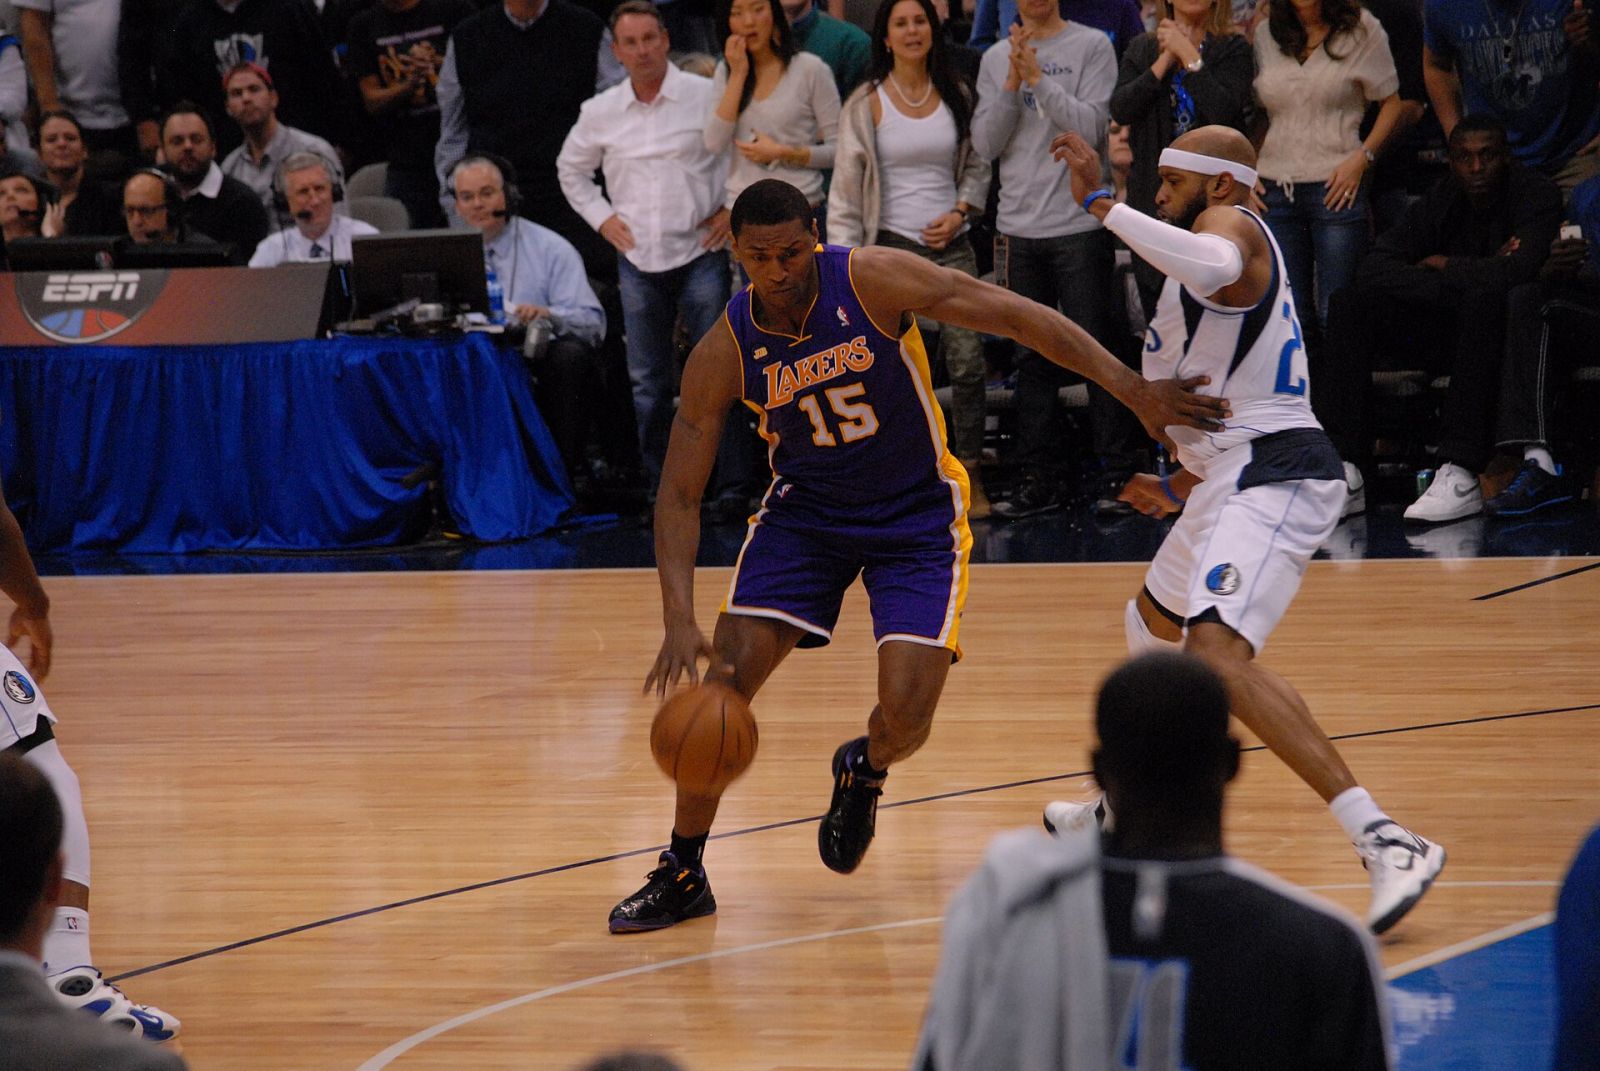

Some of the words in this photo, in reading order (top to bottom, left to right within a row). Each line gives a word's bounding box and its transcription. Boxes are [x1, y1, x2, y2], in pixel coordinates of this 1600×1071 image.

[42, 272, 141, 302] ESPN
[763, 335, 874, 410] LAKERS
[799, 382, 880, 447] 15
